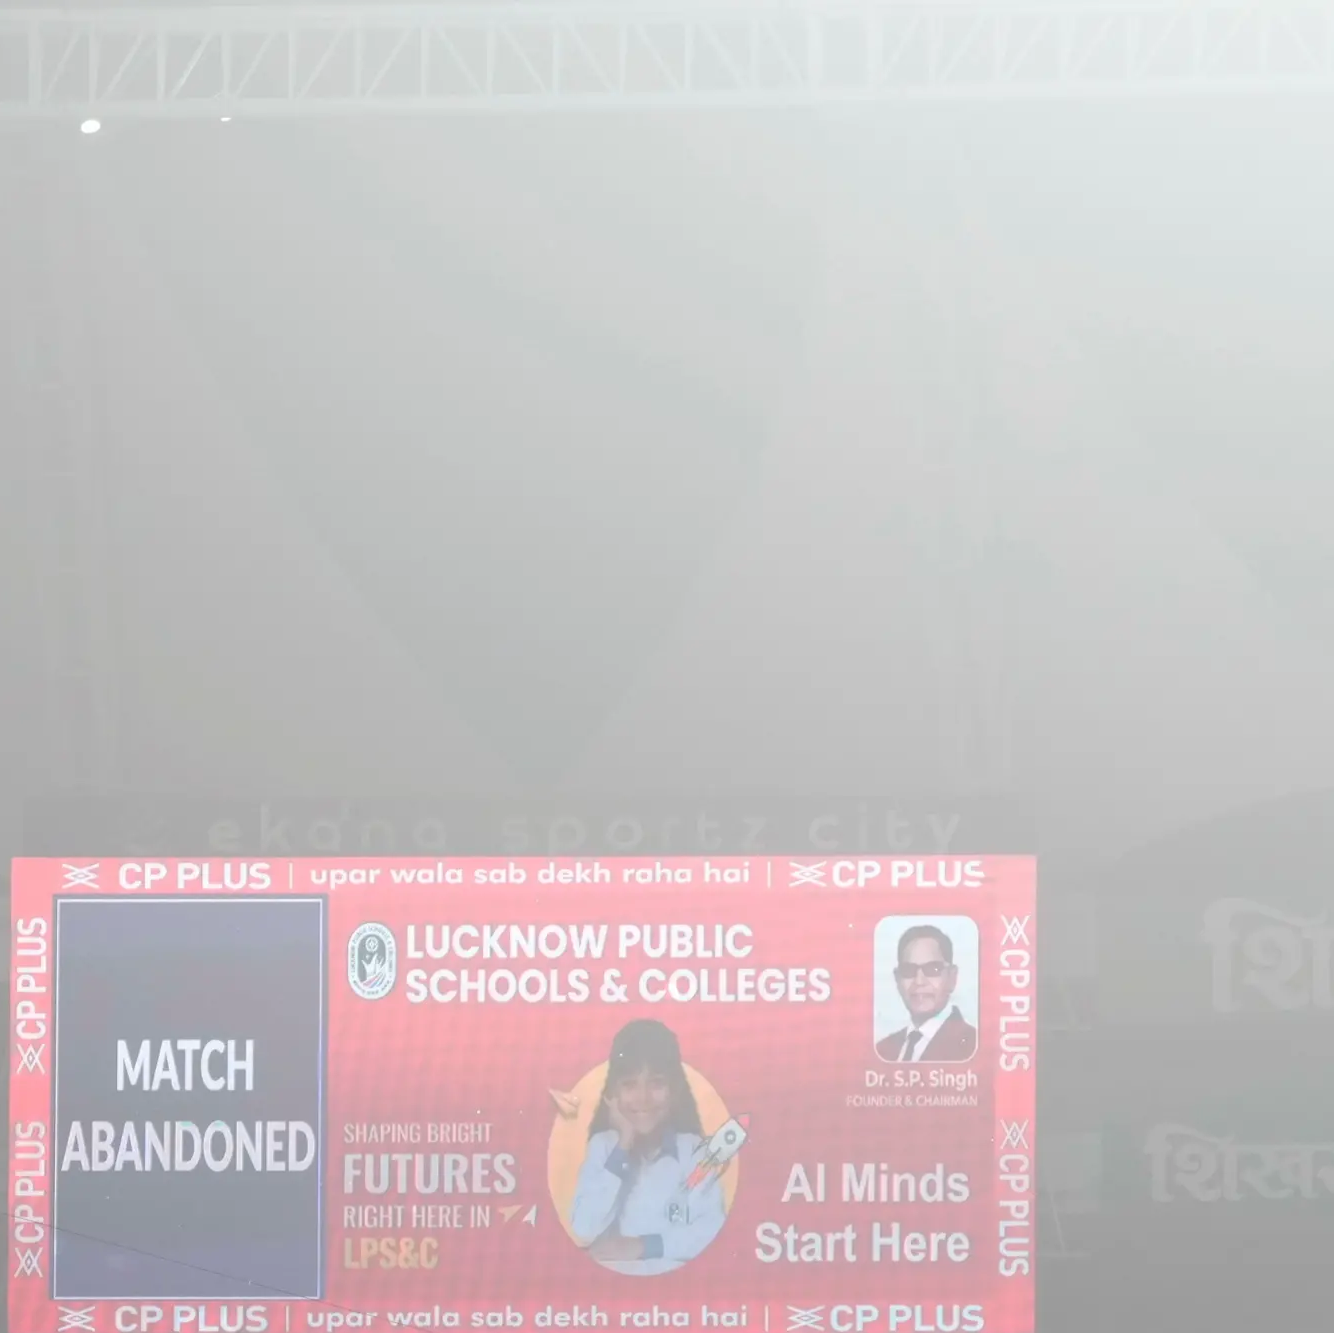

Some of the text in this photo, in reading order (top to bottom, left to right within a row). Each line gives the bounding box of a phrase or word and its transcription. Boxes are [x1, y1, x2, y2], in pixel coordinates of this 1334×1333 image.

[119, 860, 985, 890] CP PLUS upar wala sab dekh raha hai CP PLUS
[405, 923, 754, 960] LUCKNOW PUBLIC
[15, 915, 47, 1041] CP PLUS
[404, 968, 832, 1003] SCHOOLS & COLLEGES
[999, 949, 1030, 1072] CP PLUS
[116, 1039, 254, 1091] MATCH
[865, 1068, 978, 1091] Dr. S.P. Singh
[61, 1120, 316, 1172] ABANDONED
[343, 1123, 493, 1143] SHAPING BRIGHT
[15, 1120, 45, 1244] CP PLUS
[343, 1153, 516, 1194] FUTURES
[842, 1162, 970, 1202] Minds
[343, 1205, 490, 1228] RIGHT HERE IN
[999, 1154, 1030, 1277] CP PLUS
[344, 1237, 439, 1270] LPS&C
[754, 1222, 970, 1263] Start Here
[115, 1304, 985, 1333] CP PLUS upar wala sab dekh raha hai CP PLUS
